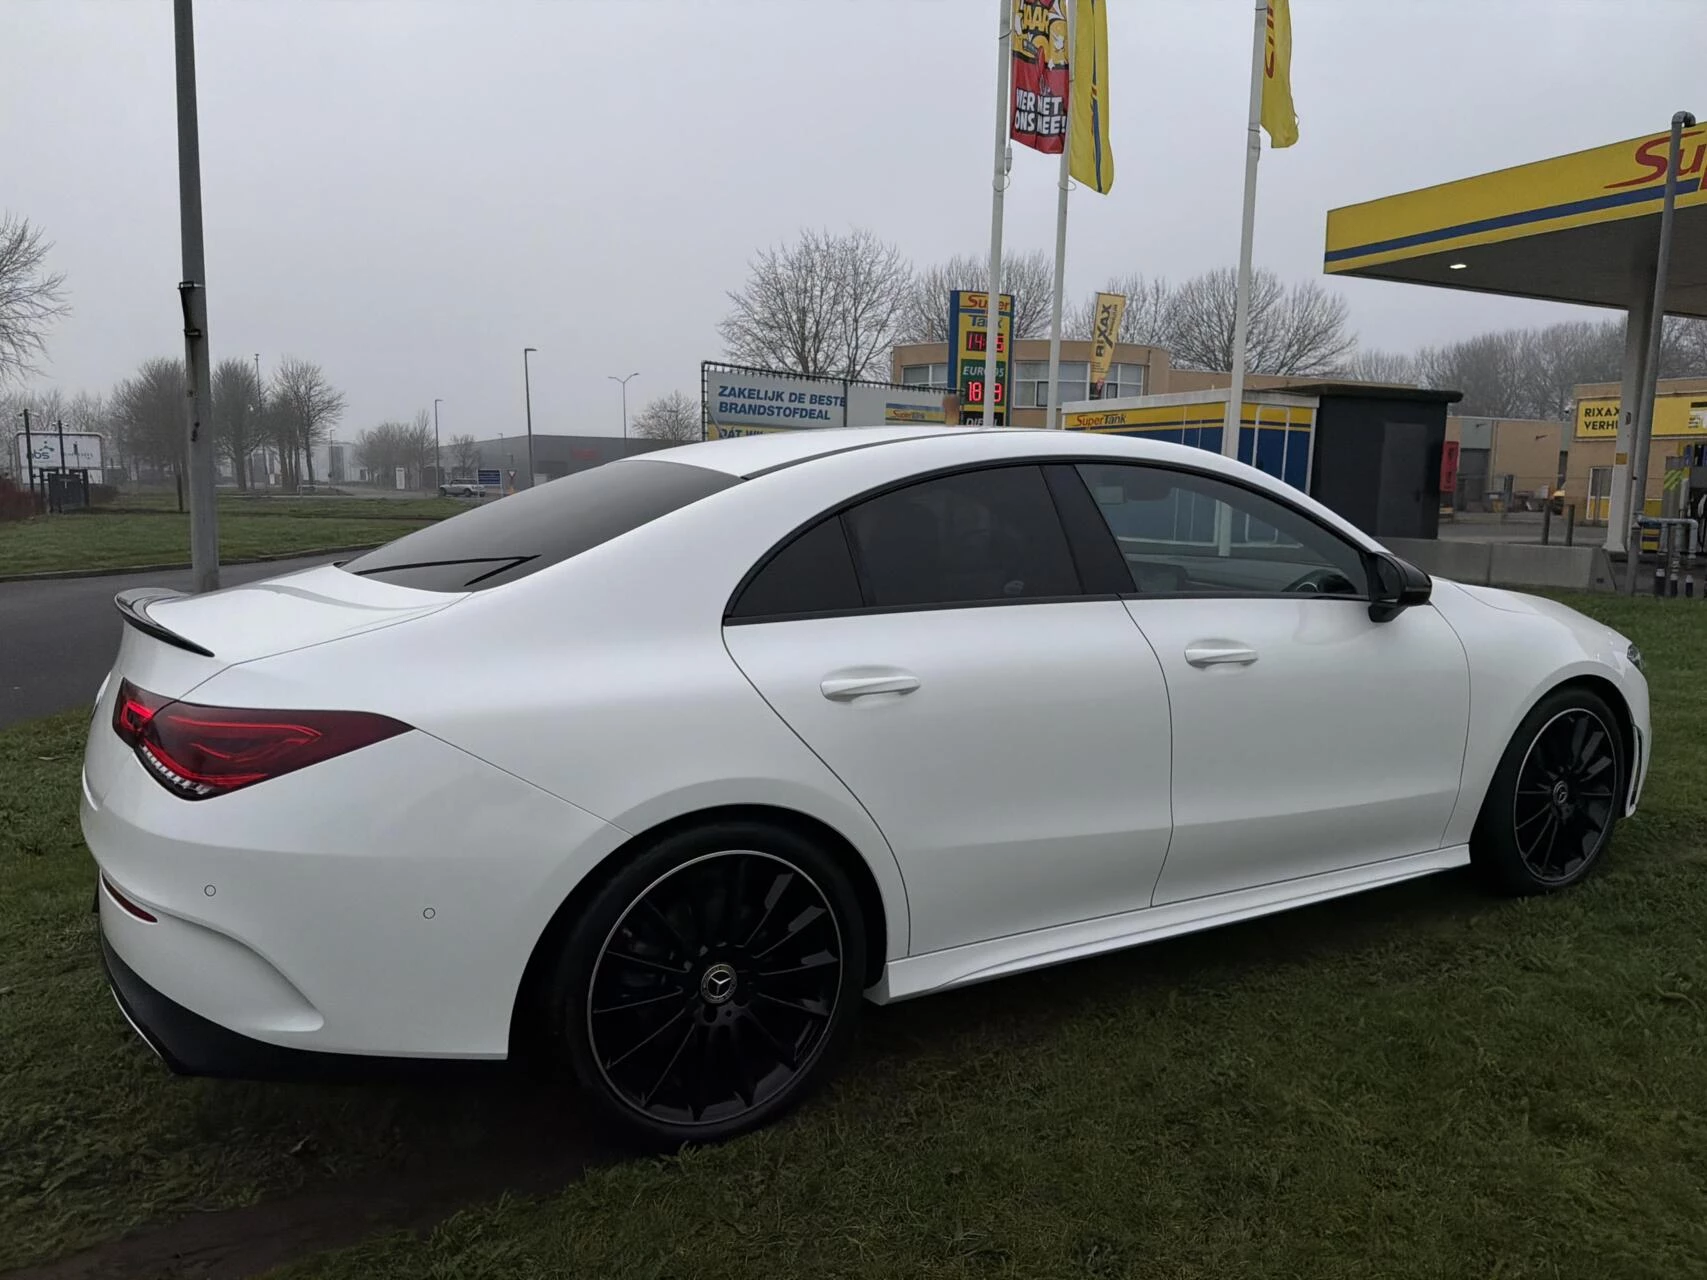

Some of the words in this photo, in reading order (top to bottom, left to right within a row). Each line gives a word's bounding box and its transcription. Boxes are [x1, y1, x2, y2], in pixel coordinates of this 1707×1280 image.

[1014, 109, 1036, 132] ONS
[963, 294, 1010, 311] Suer
[968, 315, 1003, 329] Ta
[719, 385, 785, 402] ZAKELIJK
[788, 392, 806, 404] DE
[809, 394, 847, 407] BESTE
[719, 401, 831, 421] BRANDSTOFDEAL
[1584, 407, 1620, 418] RIXAX
[1584, 420, 1618, 431] VERH
